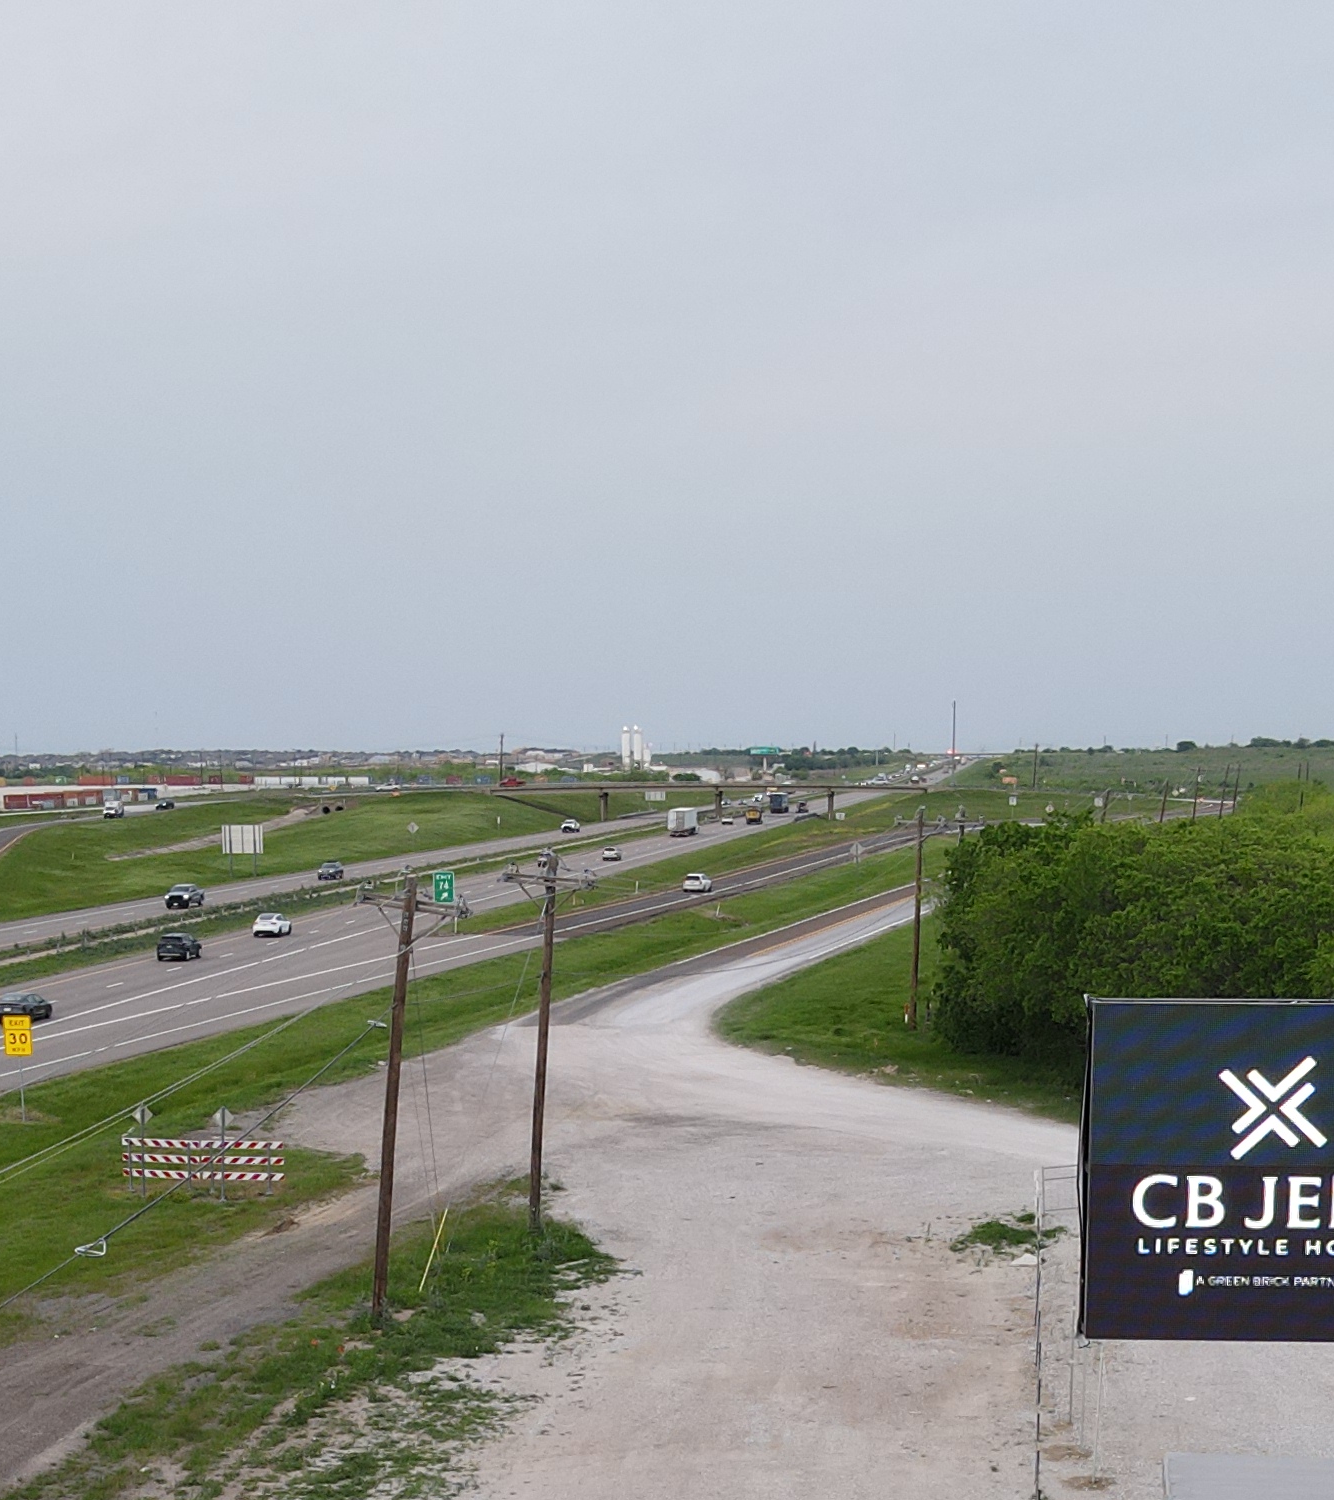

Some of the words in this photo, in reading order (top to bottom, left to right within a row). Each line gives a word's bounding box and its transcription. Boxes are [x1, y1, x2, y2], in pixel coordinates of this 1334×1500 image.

[9, 1033, 27, 1044] 30
[1132, 1173, 1225, 1230] CB
[1137, 1238, 1289, 1256] LIFESTYLE
[1196, 1276, 1205, 1286] A
[1207, 1275, 1250, 1287] GREEN
